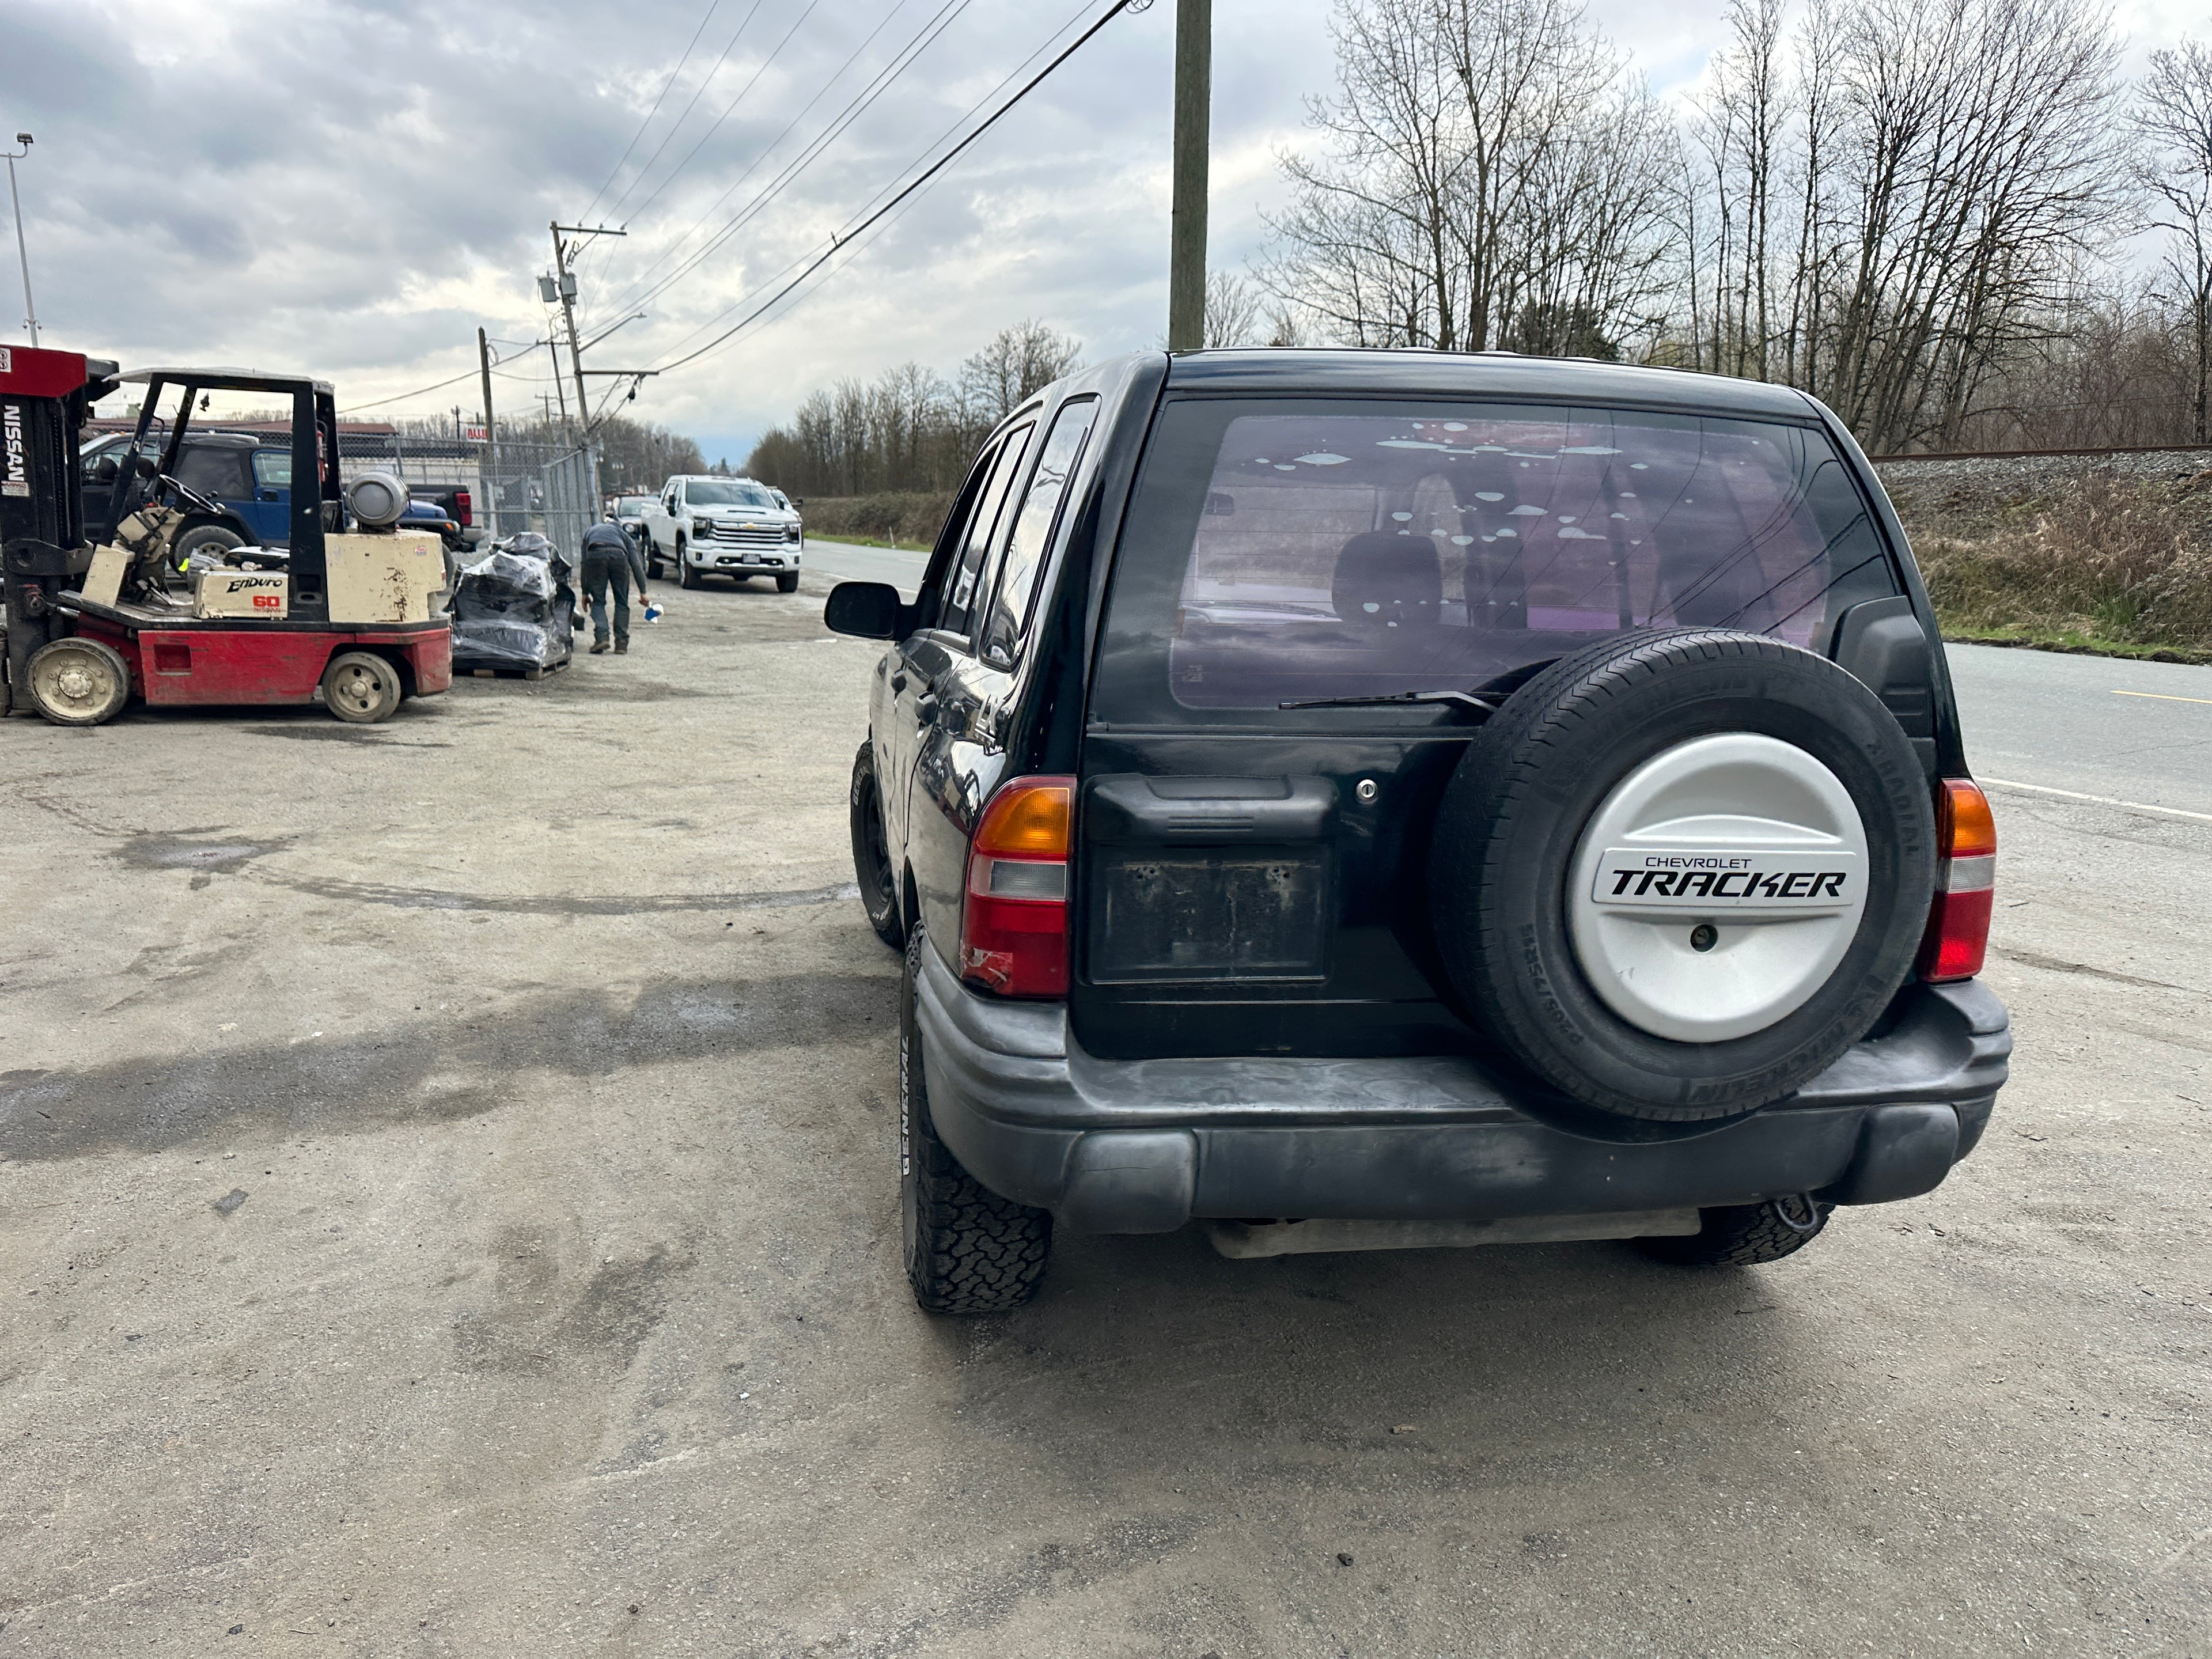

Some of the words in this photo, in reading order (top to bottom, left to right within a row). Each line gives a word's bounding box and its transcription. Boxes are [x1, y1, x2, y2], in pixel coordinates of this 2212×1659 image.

[4, 405, 24, 480] NISSAN
[253, 596, 280, 607] 60
[1645, 857, 1752, 869] CHEVROLET
[1611, 869, 1847, 897] TRACKER
[902, 1036, 910, 1176] GENERAL
